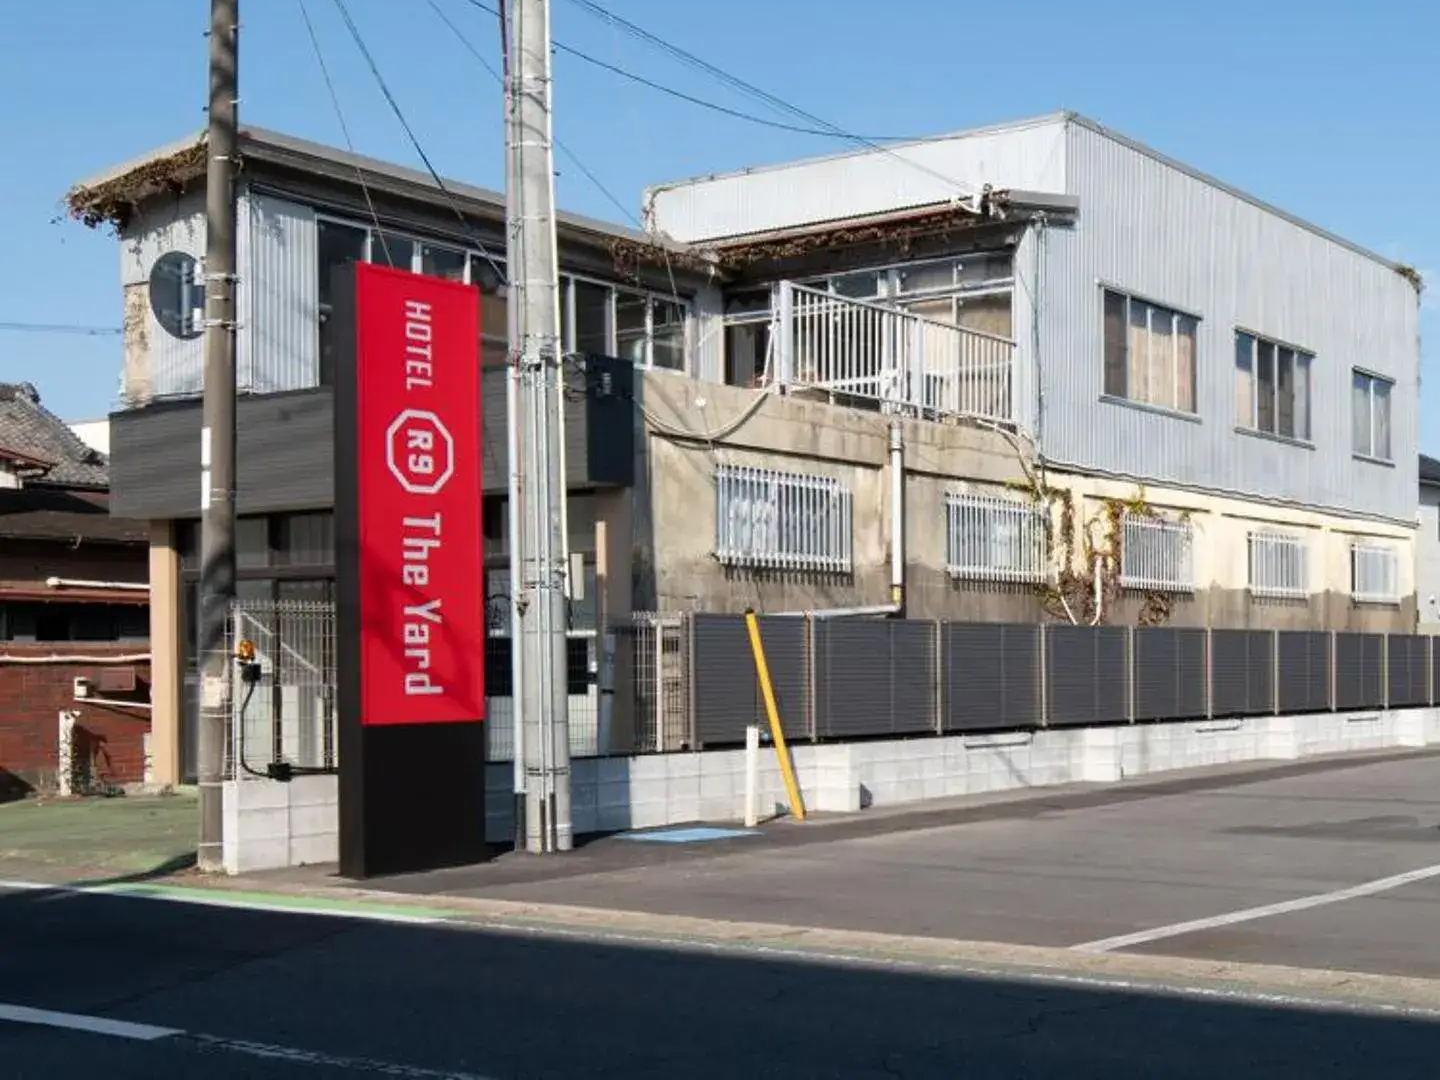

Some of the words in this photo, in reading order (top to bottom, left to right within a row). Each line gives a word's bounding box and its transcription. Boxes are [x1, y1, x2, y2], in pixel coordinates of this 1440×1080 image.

[405, 300, 432, 390] HOTEL
[406, 428, 434, 476] R9
[402, 512, 441, 586] The
[403, 599, 443, 696] Yard
